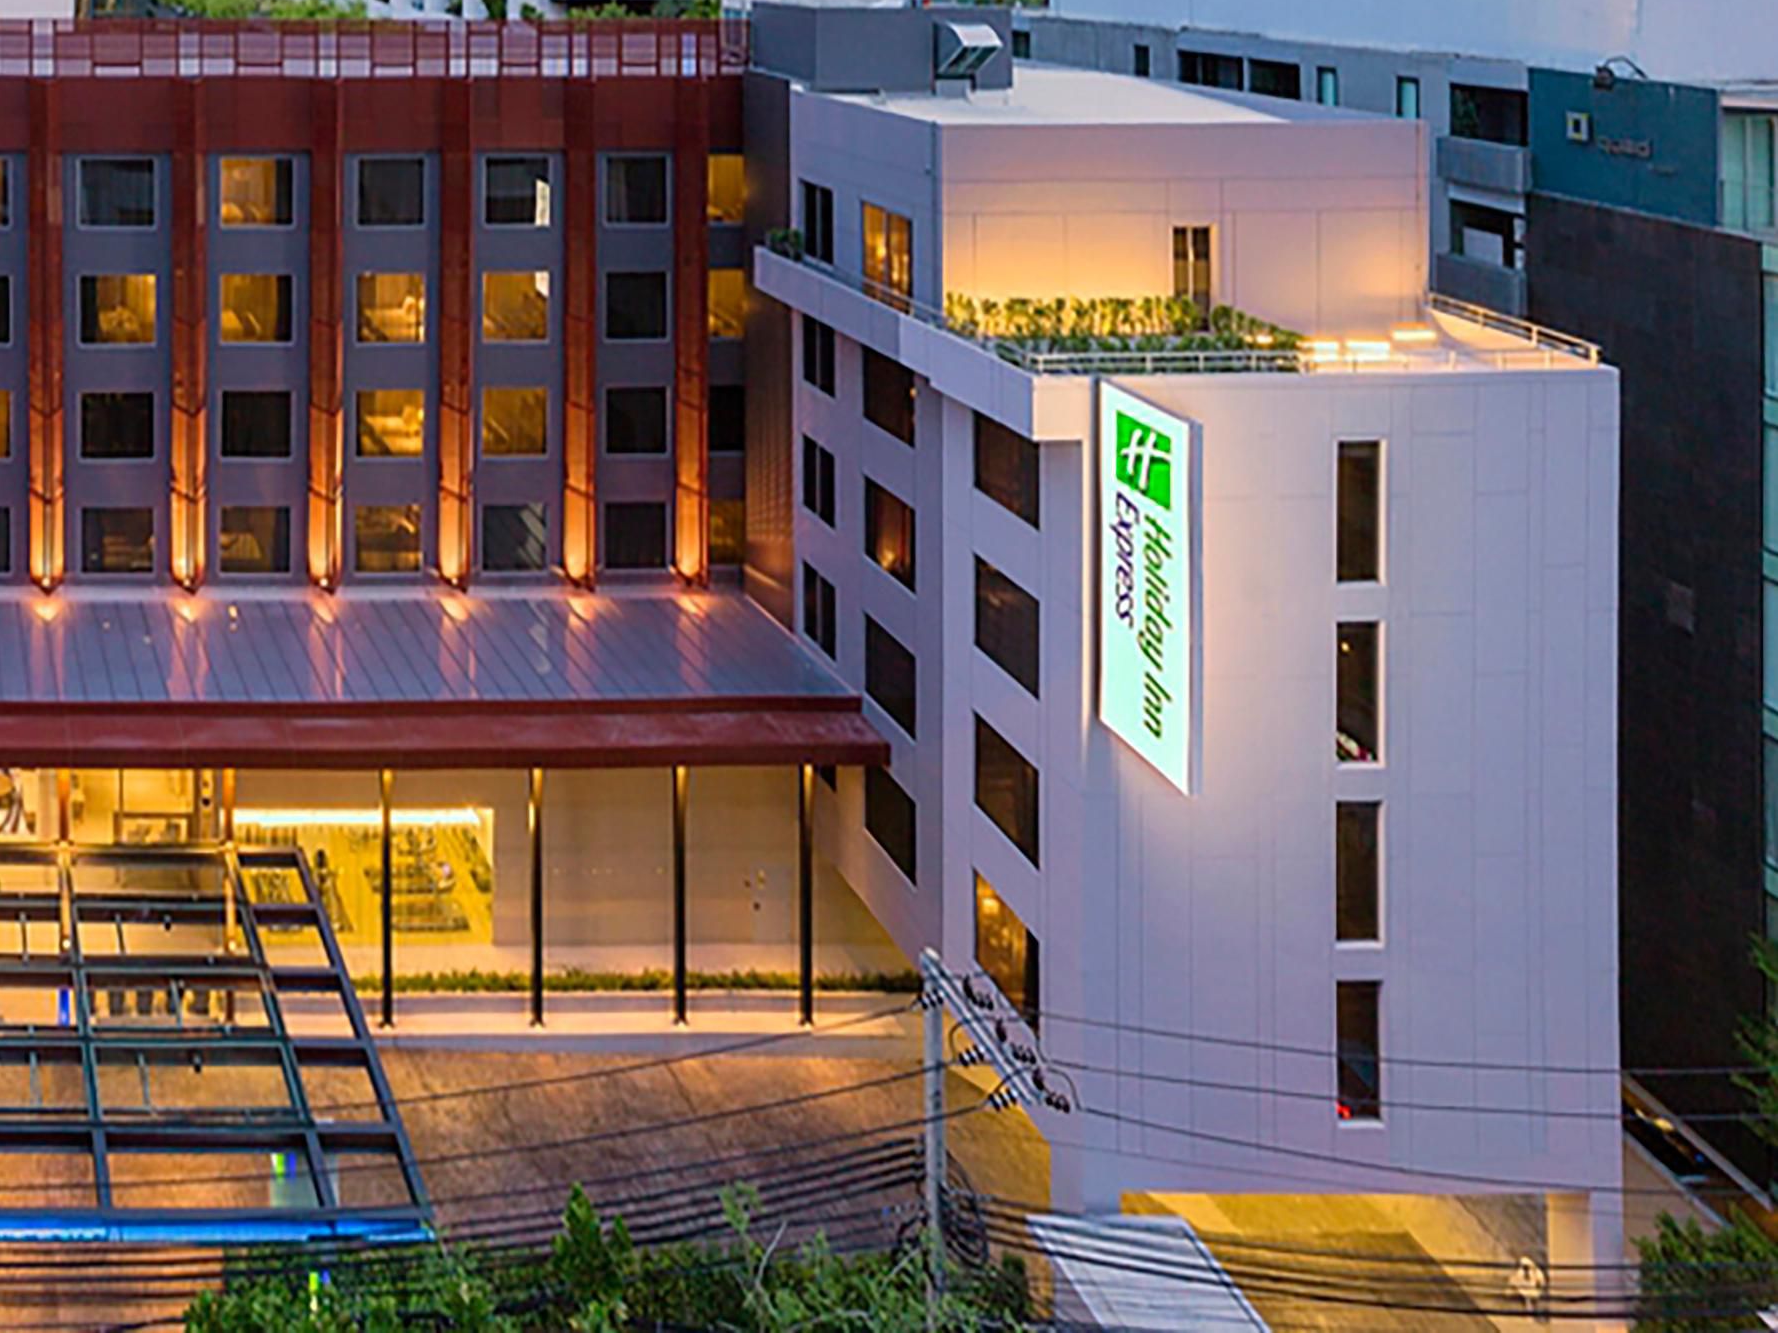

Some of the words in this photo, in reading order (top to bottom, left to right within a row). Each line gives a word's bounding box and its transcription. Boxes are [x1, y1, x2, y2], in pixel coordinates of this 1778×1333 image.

[1109, 491, 1140, 629] Express
[1136, 514, 1172, 672] Holiday
[1143, 670, 1172, 739] Inn
